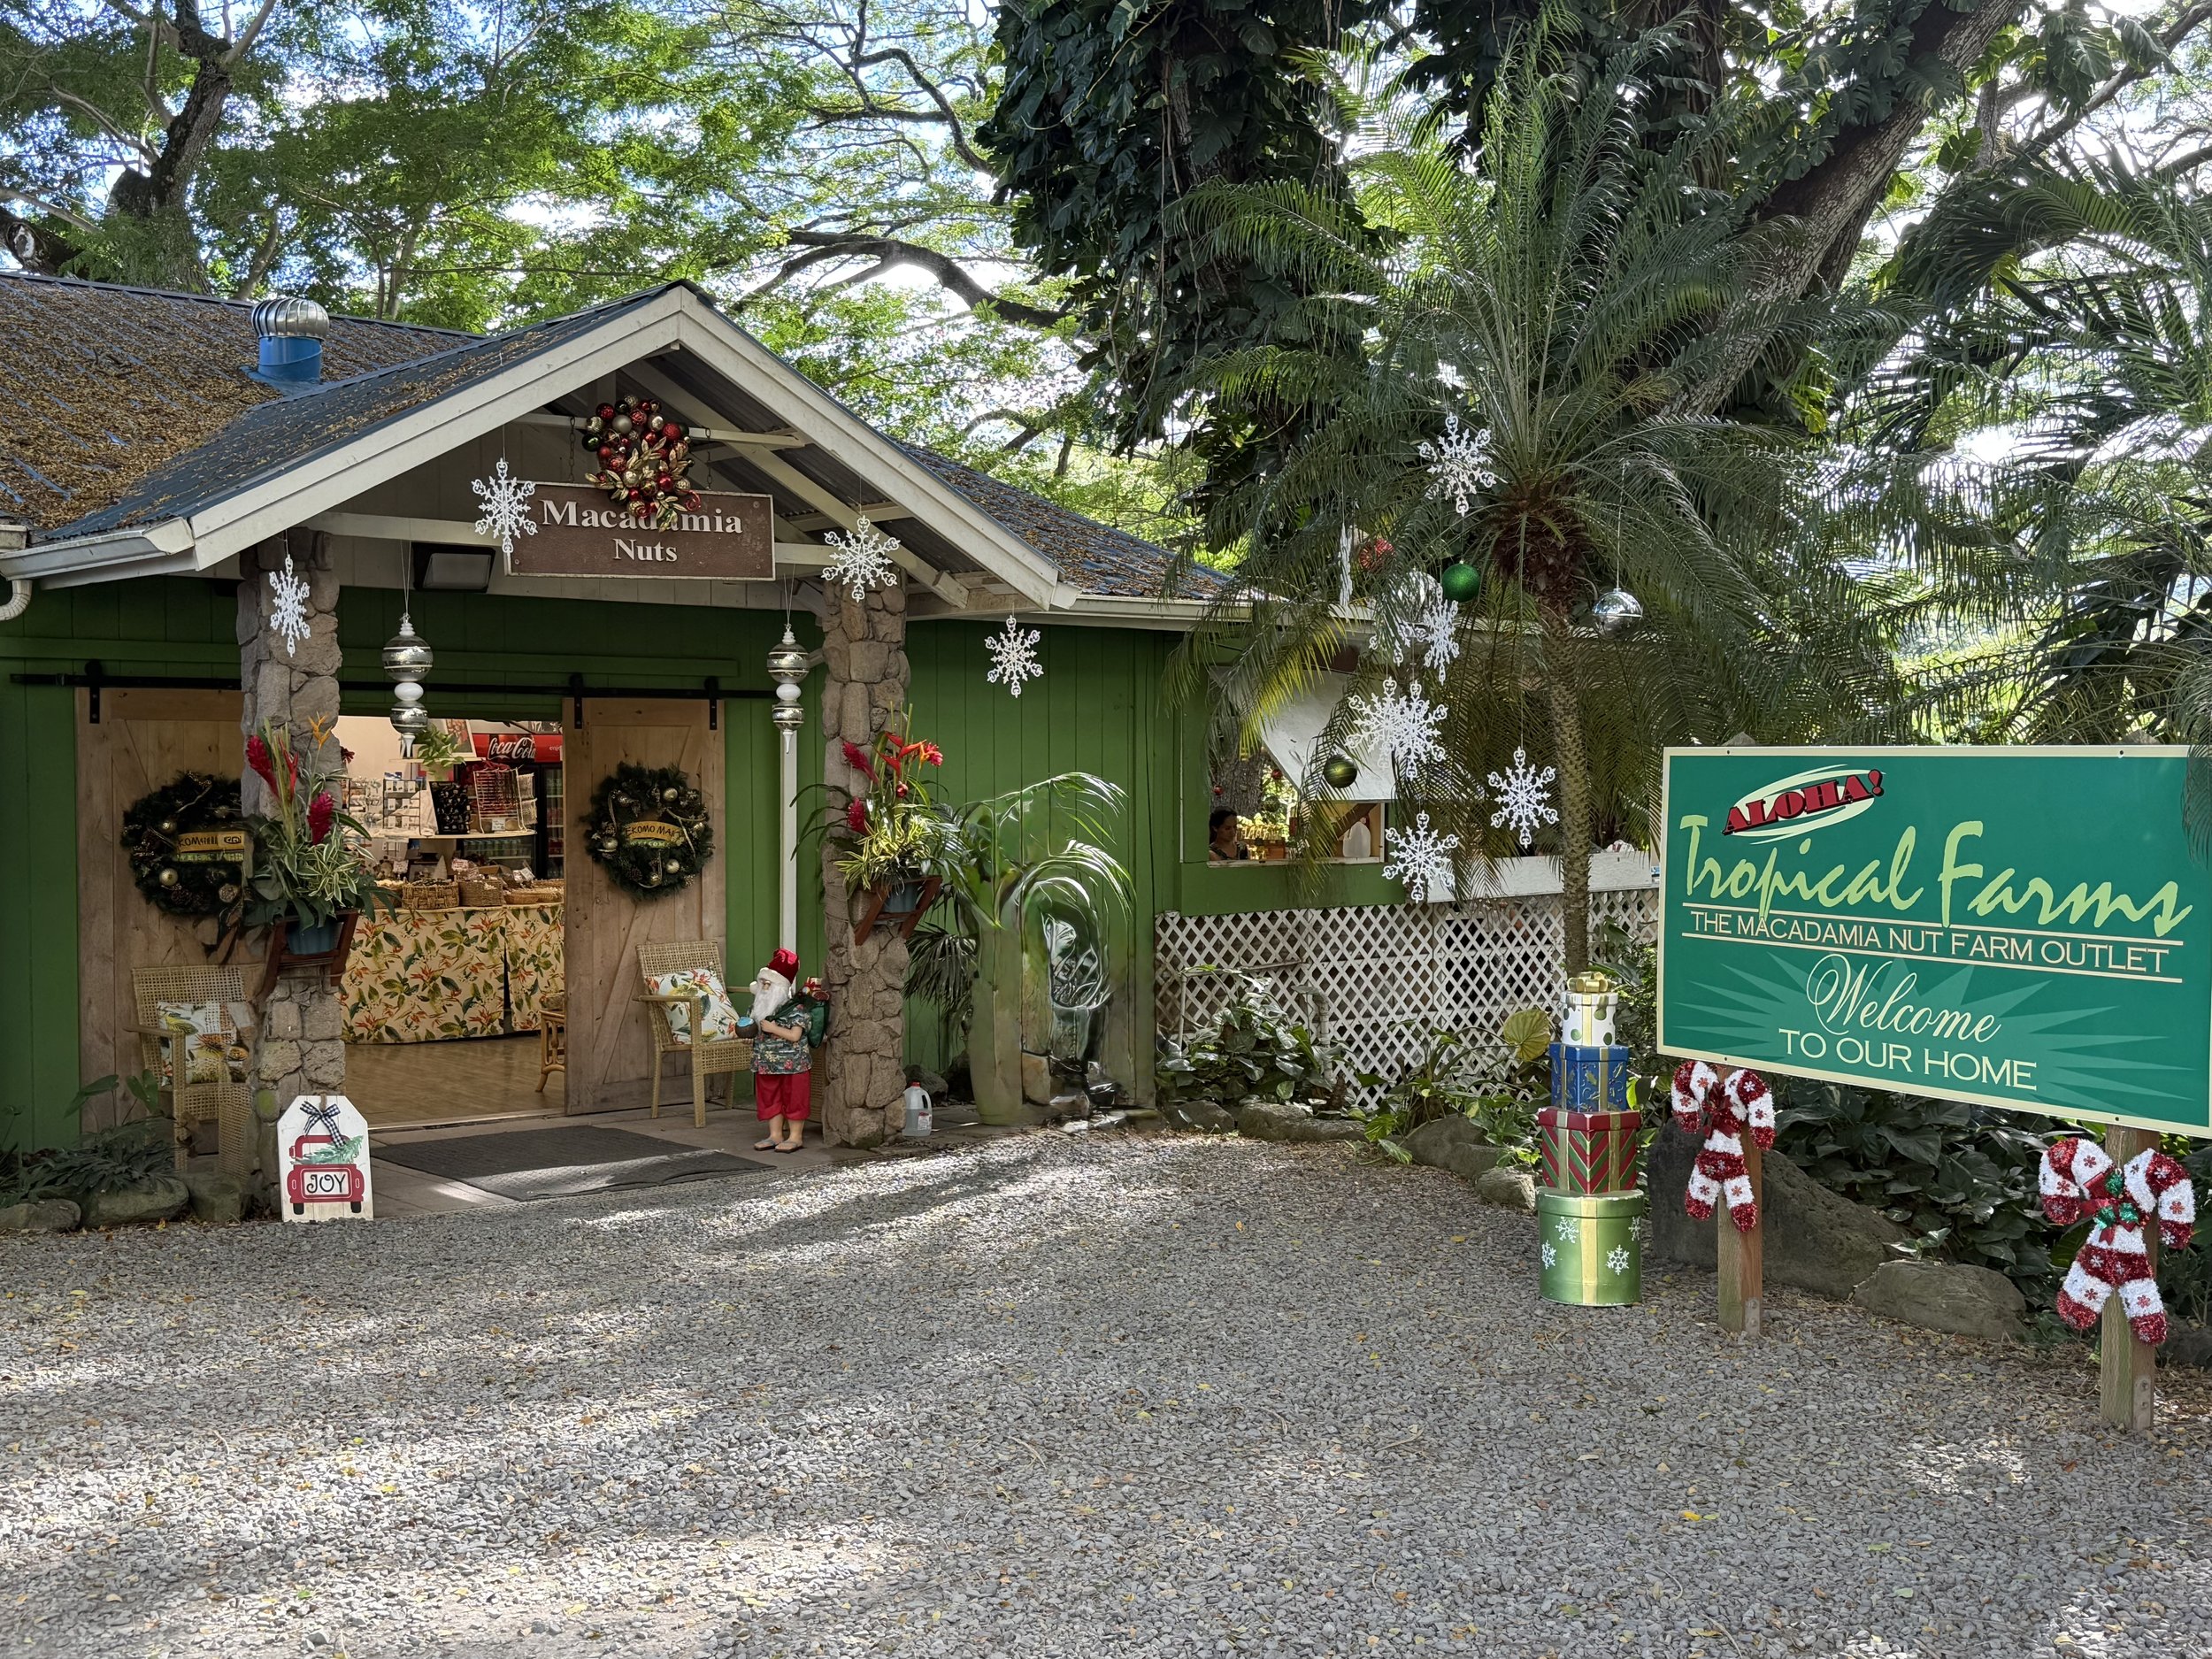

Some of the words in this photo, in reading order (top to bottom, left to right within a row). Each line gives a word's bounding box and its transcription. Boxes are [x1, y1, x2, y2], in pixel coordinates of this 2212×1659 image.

[612, 538, 679, 563] Nuts
[1722, 769, 1886, 836] ALOHA!
[1680, 815, 1924, 919] Tropical
[1939, 820, 2193, 937] Farms
[1690, 910, 1732, 934] THE
[1737, 915, 1881, 949] MACADAMIA
[1888, 927, 1944, 954] NUT
[1951, 933, 2033, 962] FARM
[2040, 940, 2169, 973] OUTLET
[1806, 953, 2001, 1043] Welcome
[1778, 1029, 1827, 1057] TO
[1836, 1037, 1914, 1072] OUR
[1924, 1049, 2037, 1091] HOME
[306, 1174, 346, 1194] JOY
